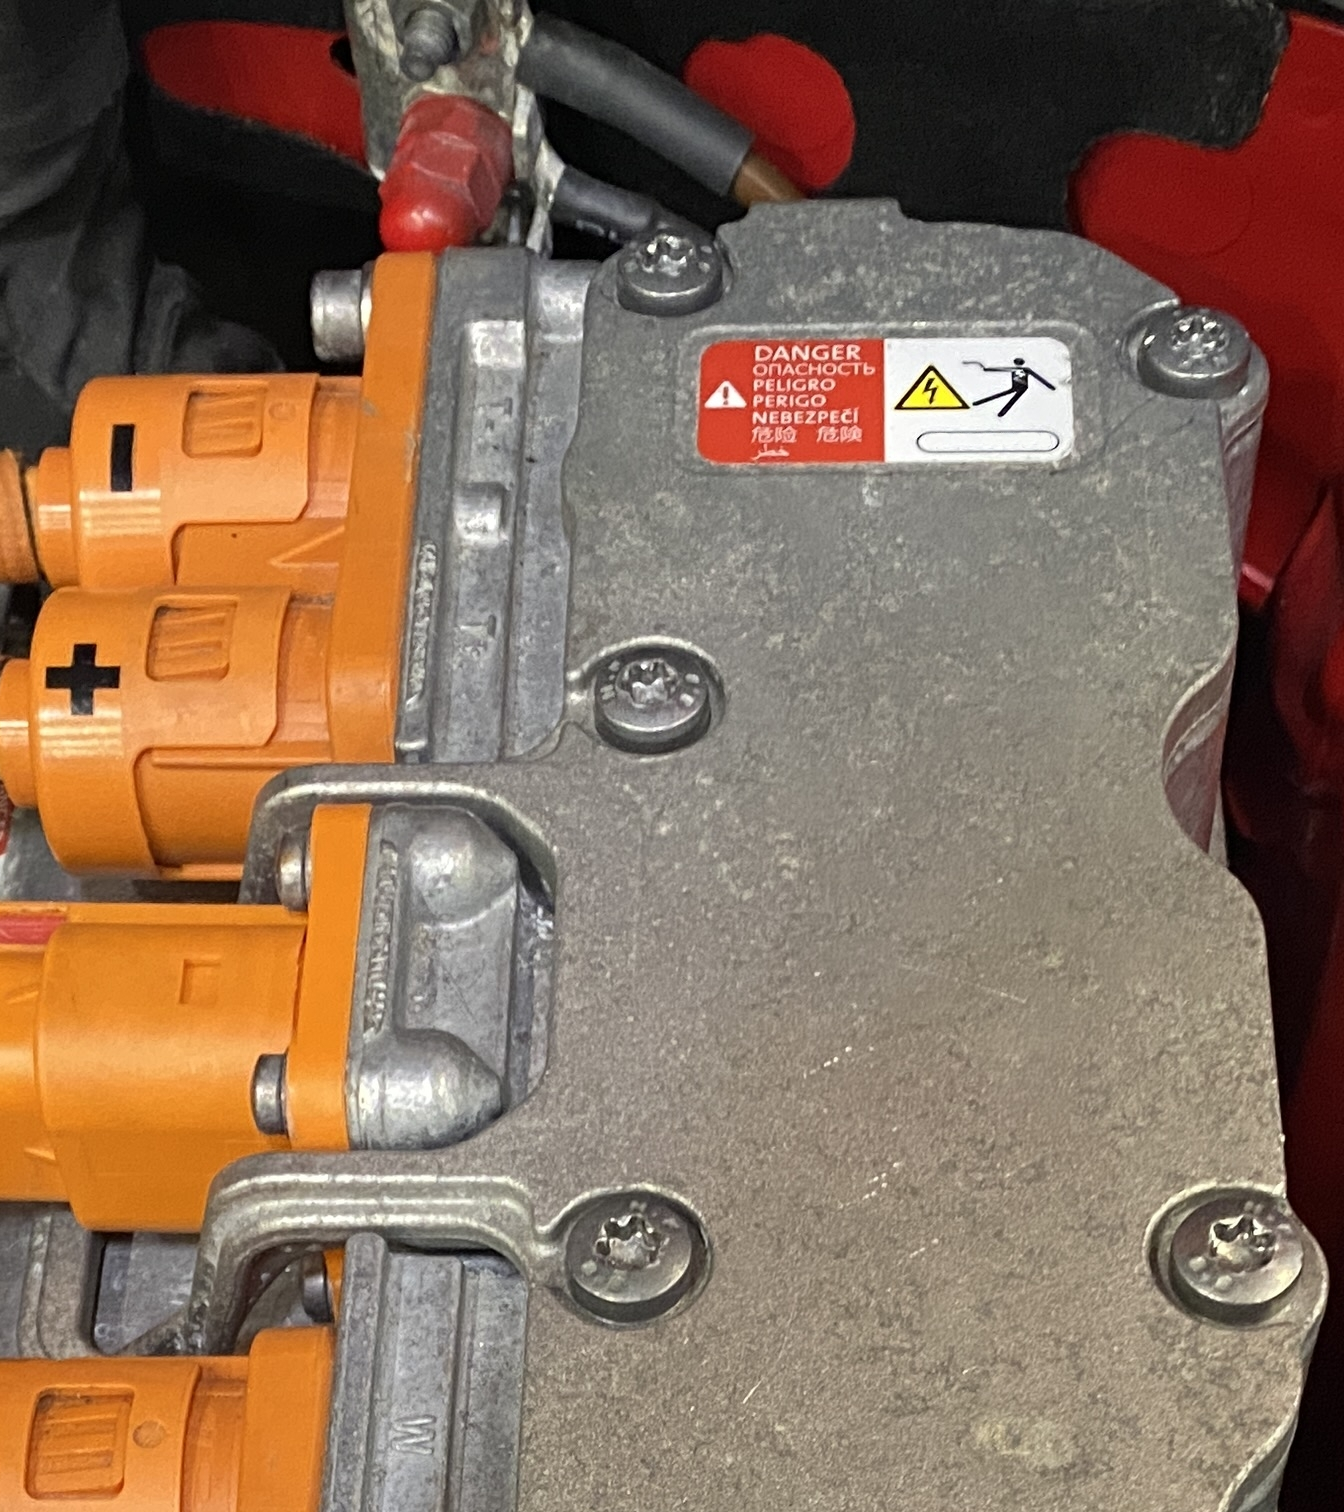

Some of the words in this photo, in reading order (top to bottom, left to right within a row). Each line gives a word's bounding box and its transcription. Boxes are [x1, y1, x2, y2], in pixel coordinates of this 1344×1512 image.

[754, 344, 861, 361] DANGER
[752, 361, 876, 377] ОПАСНОСТЬ
[753, 377, 836, 392] PELIGRO
[752, 393, 827, 408] PERIGO
[752, 406, 860, 425] NEBEZPEČÍ
[391, 1414, 437, 1455] W
